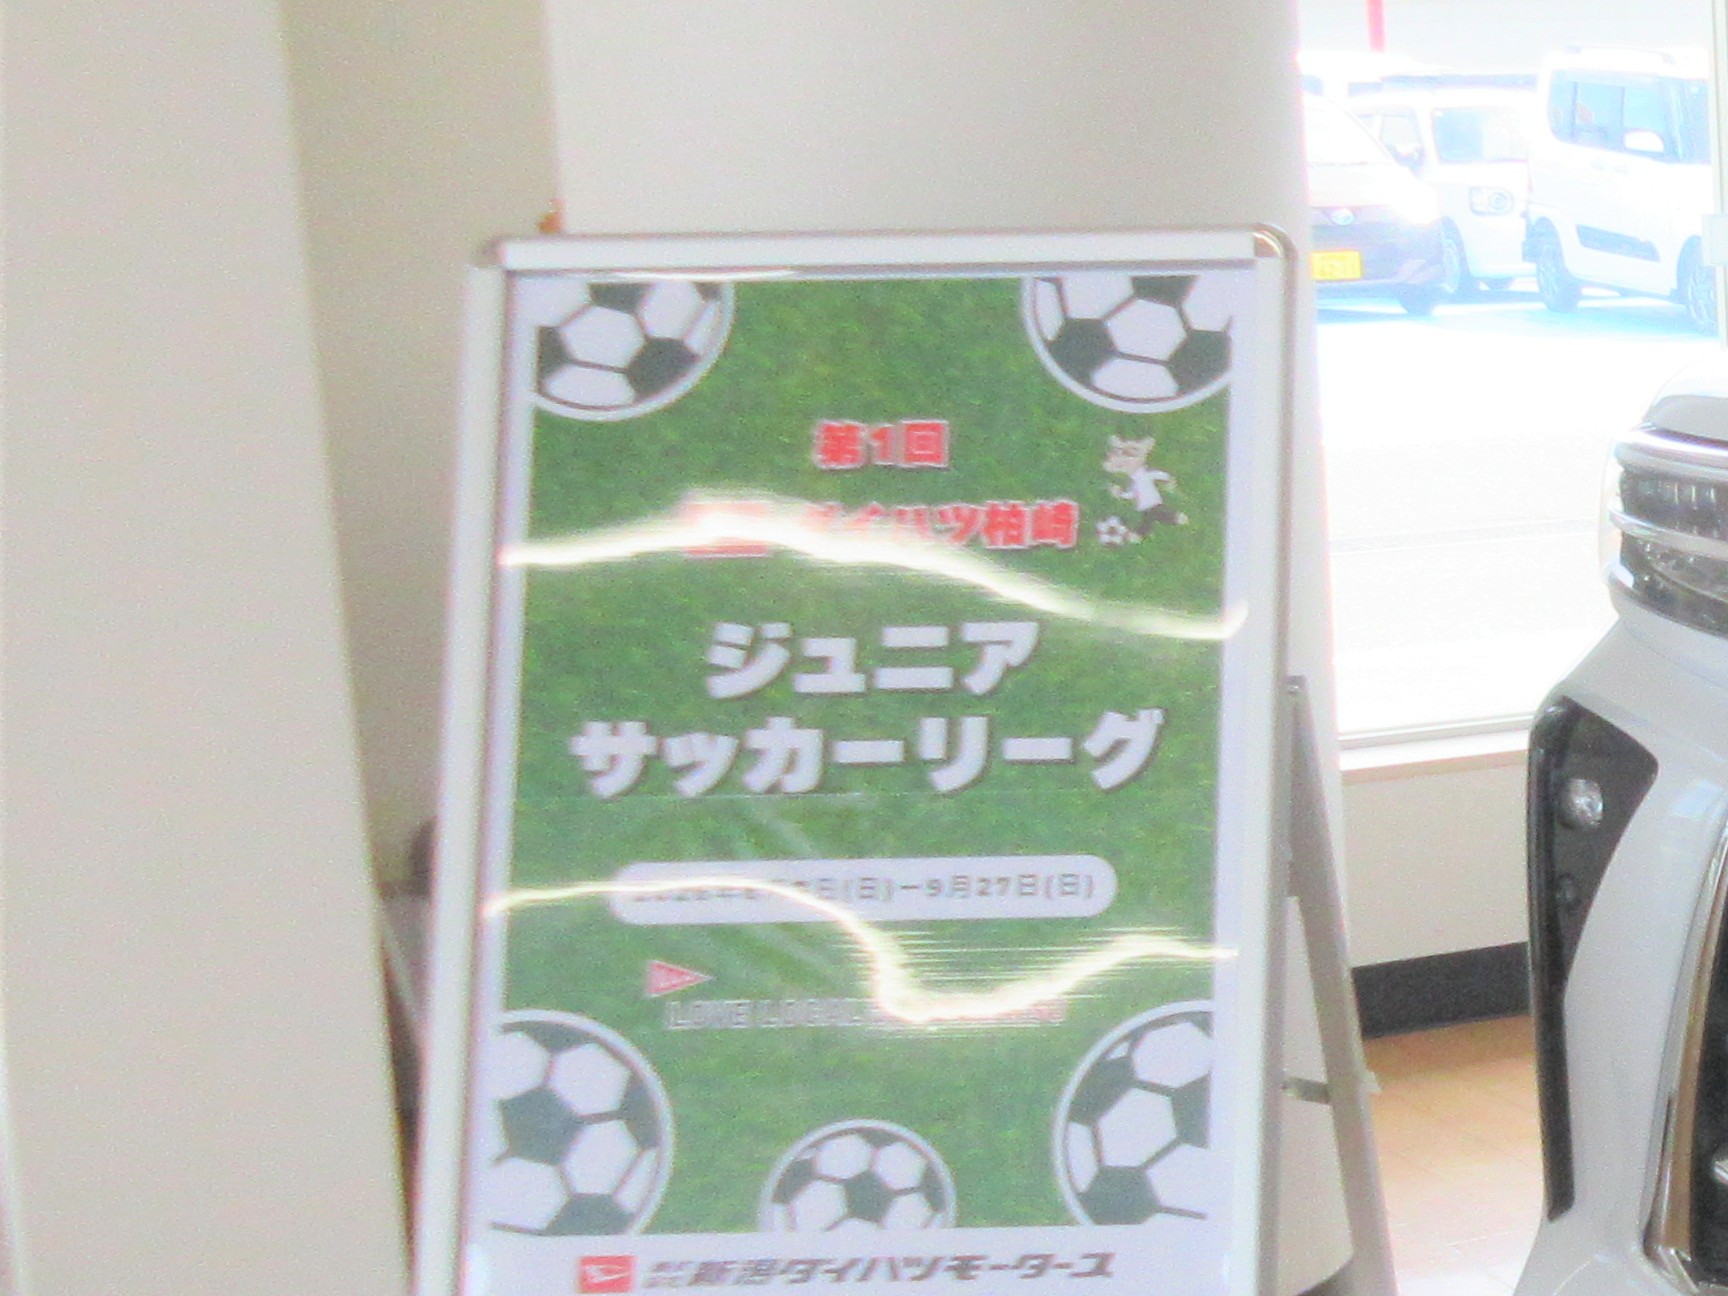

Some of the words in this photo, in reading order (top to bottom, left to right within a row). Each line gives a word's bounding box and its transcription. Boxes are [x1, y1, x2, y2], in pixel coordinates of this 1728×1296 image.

[815, 420, 948, 468] 第1回
[706, 621, 1040, 699] ジュニア
[570, 708, 1164, 799] サッカーリーグ
